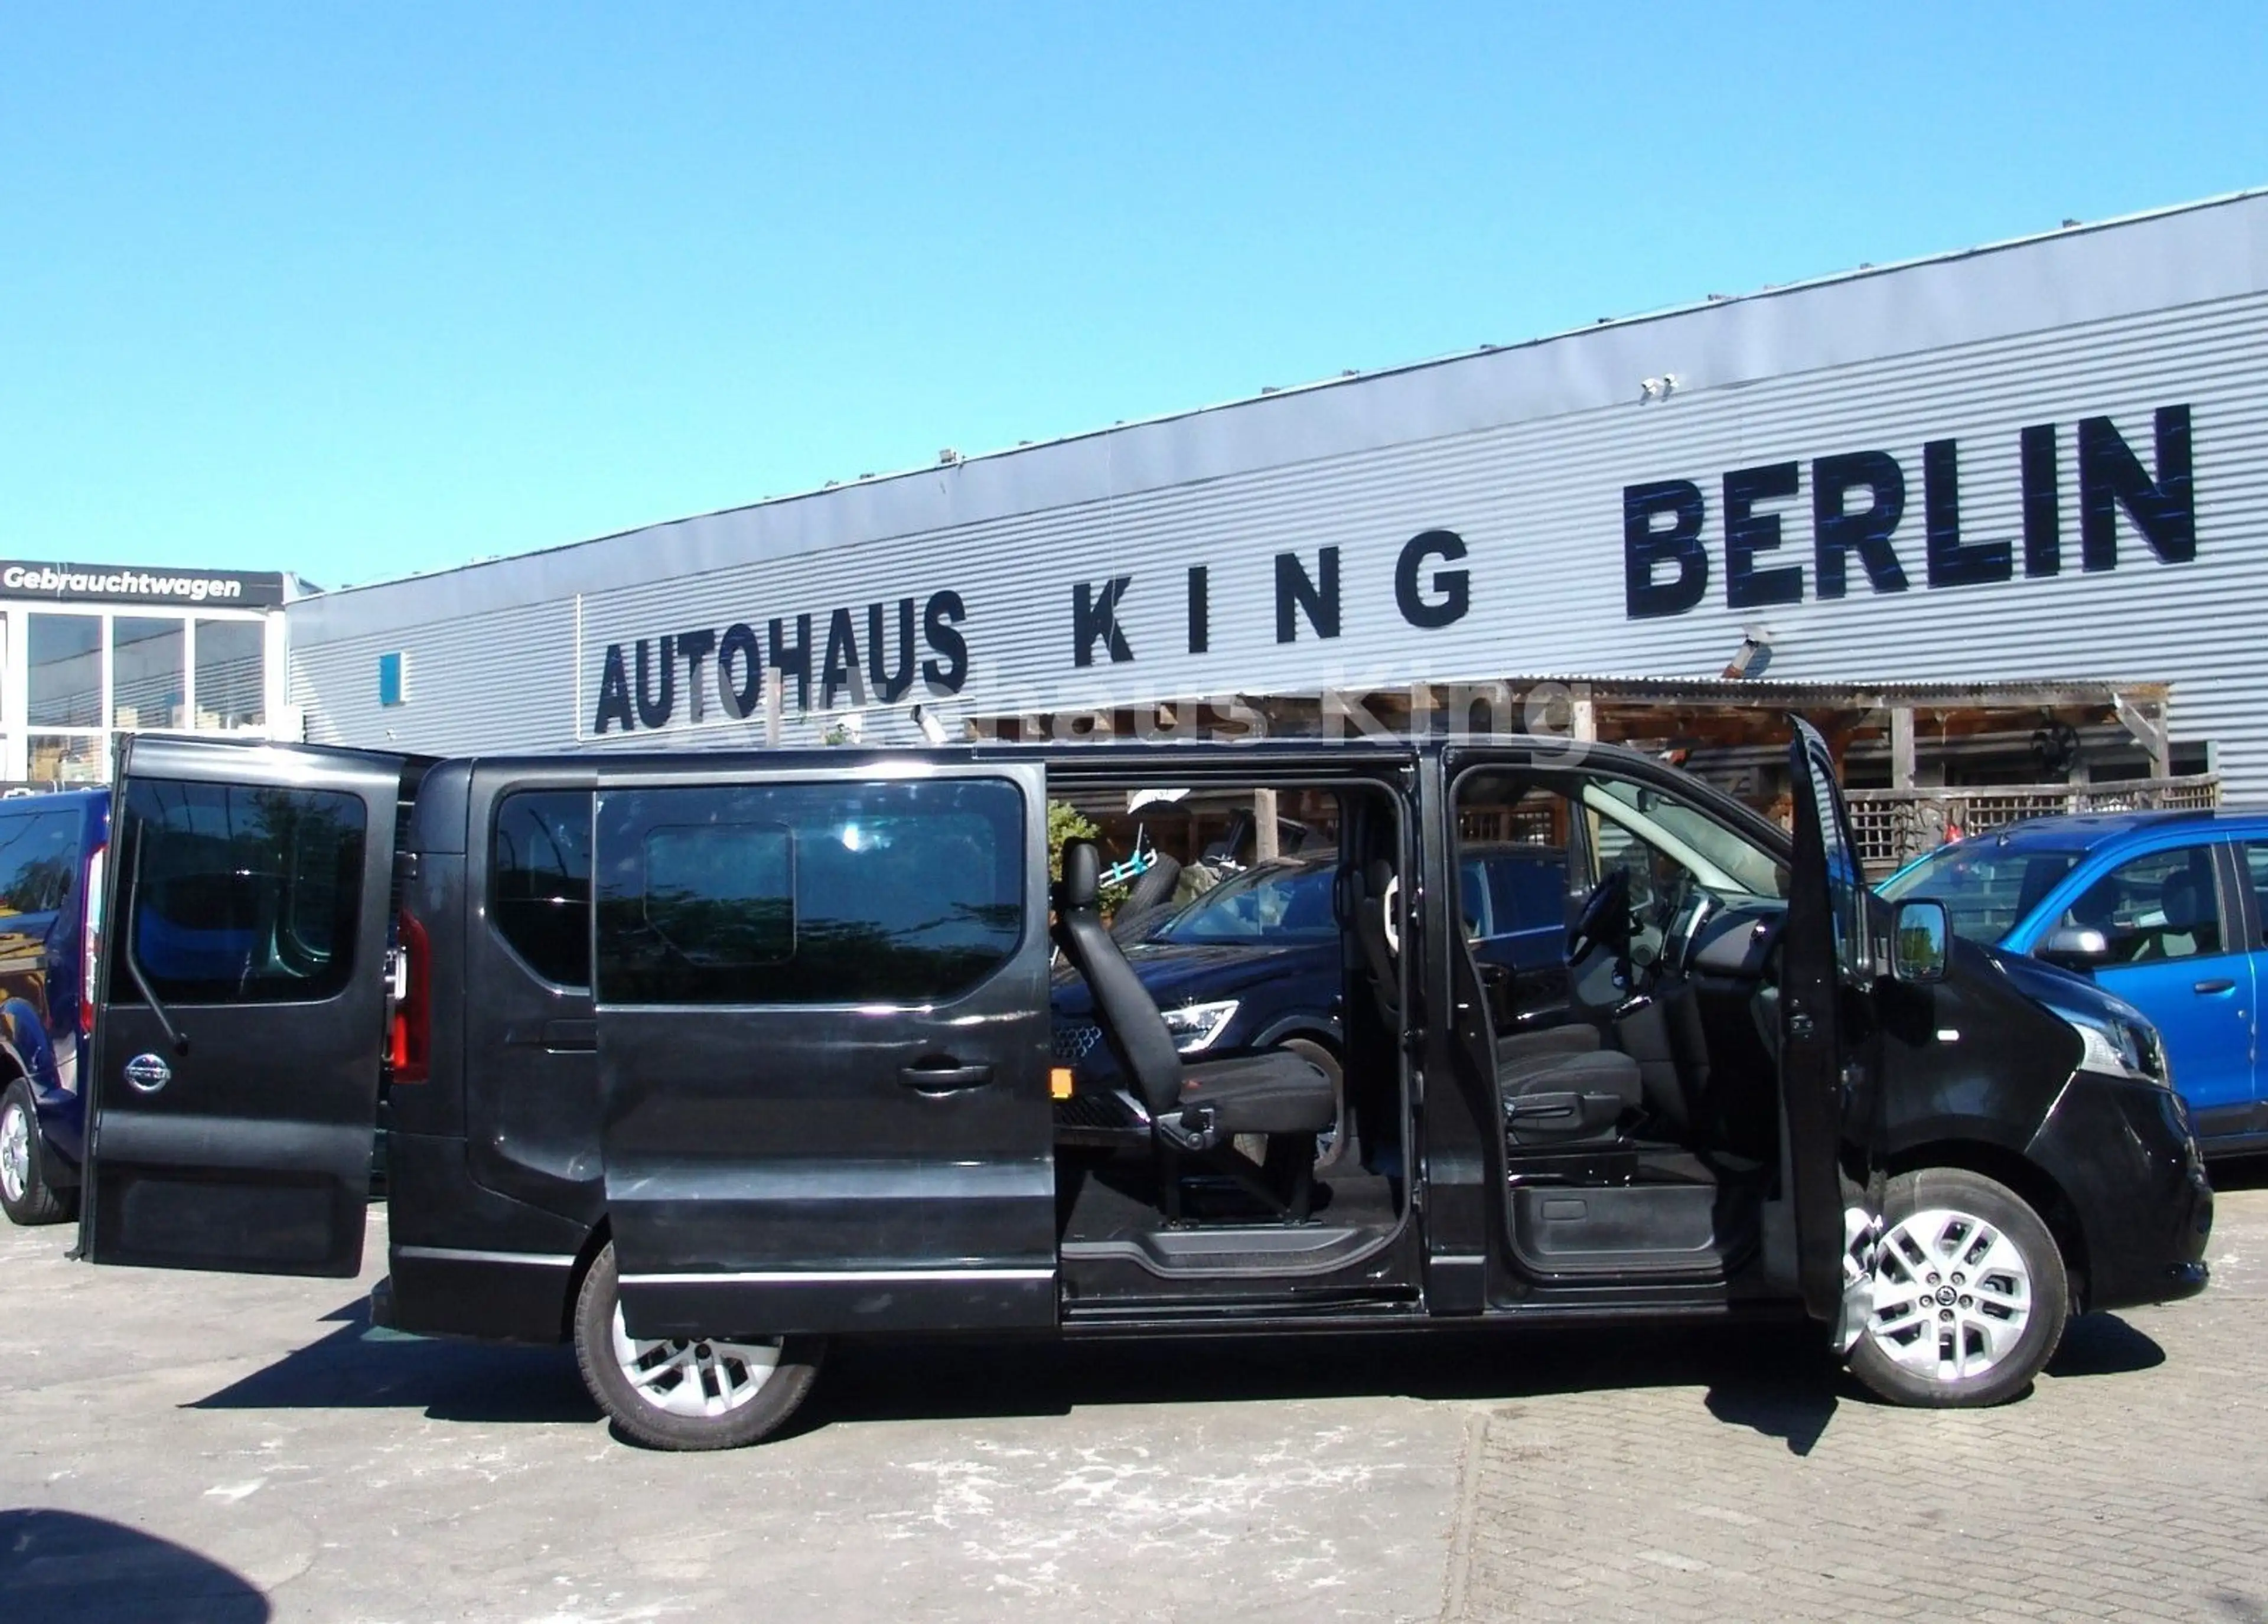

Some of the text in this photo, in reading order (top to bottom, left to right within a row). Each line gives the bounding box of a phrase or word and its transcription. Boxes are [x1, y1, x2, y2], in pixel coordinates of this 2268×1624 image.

[3, 568, 241, 600] Gebrauchtwagen
[594, 590, 967, 733] AUTOHAUS
[1624, 404, 2197, 620] BERLIN
